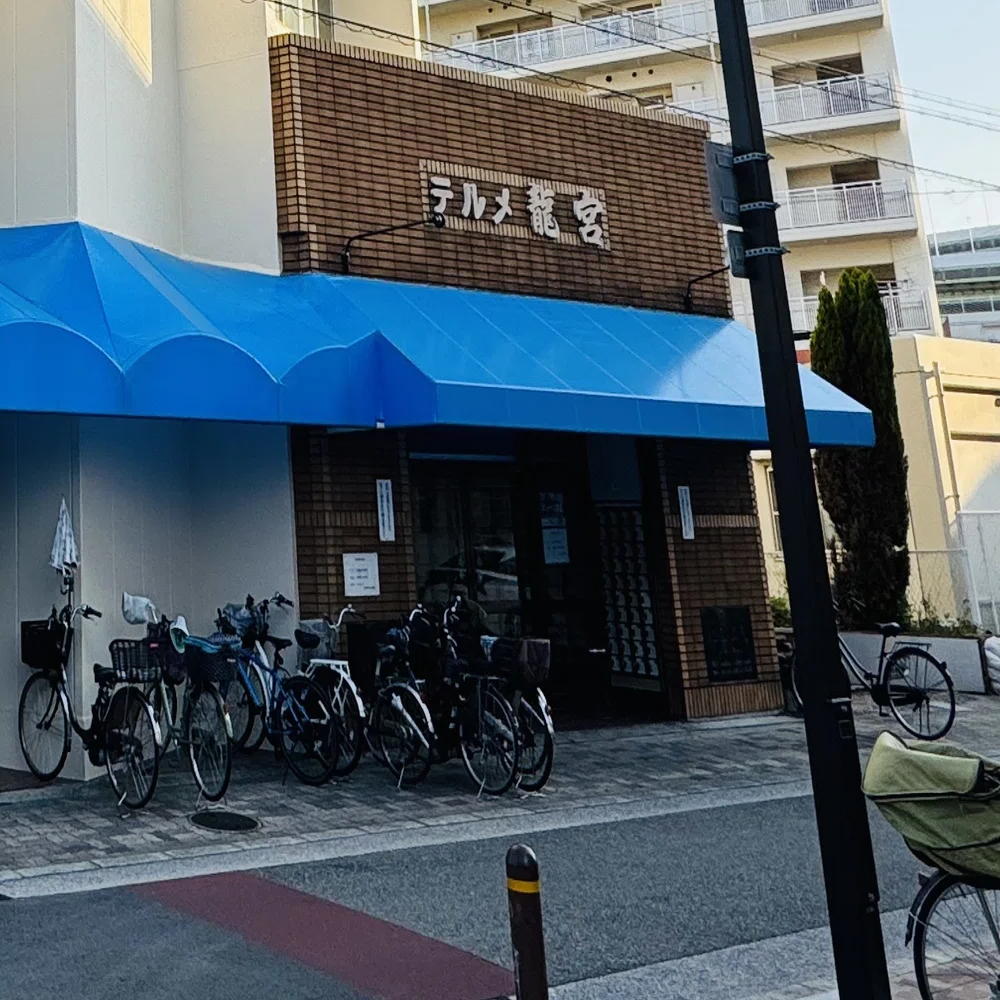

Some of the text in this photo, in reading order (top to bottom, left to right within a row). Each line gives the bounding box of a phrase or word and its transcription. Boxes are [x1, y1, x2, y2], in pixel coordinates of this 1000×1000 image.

[430, 176, 604, 249] テルメ龍宮
